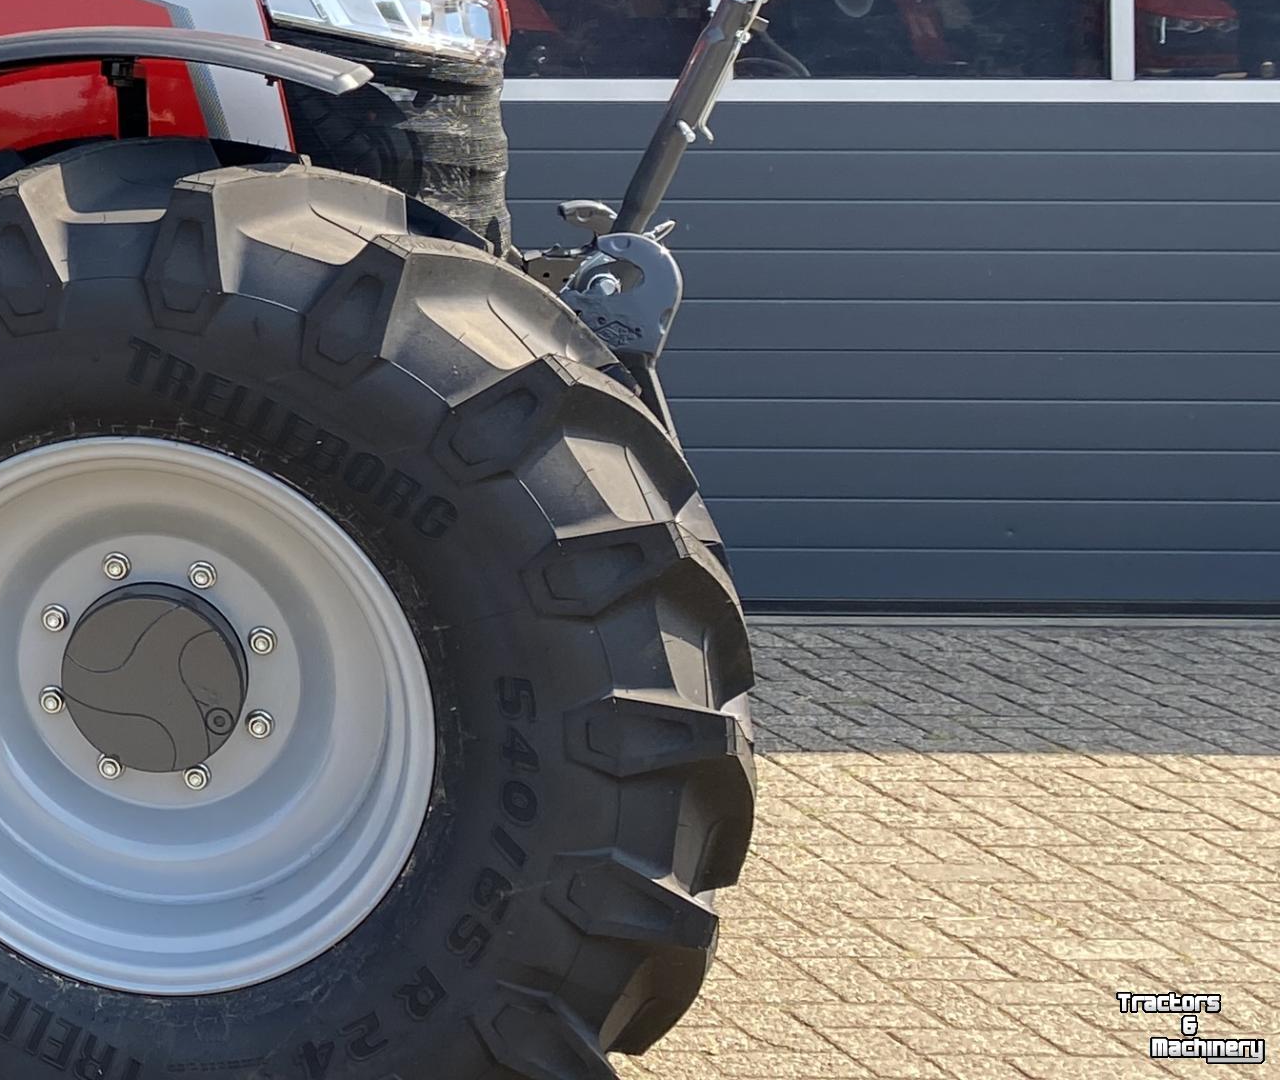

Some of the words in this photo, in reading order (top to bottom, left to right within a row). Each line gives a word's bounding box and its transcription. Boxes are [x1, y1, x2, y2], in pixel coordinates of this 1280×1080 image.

[126, 335, 458, 539] TRELLEBORG
[445, 675, 542, 968] 540/65
[299, 1011, 389, 1080] 24
[392, 964, 449, 1022] R
